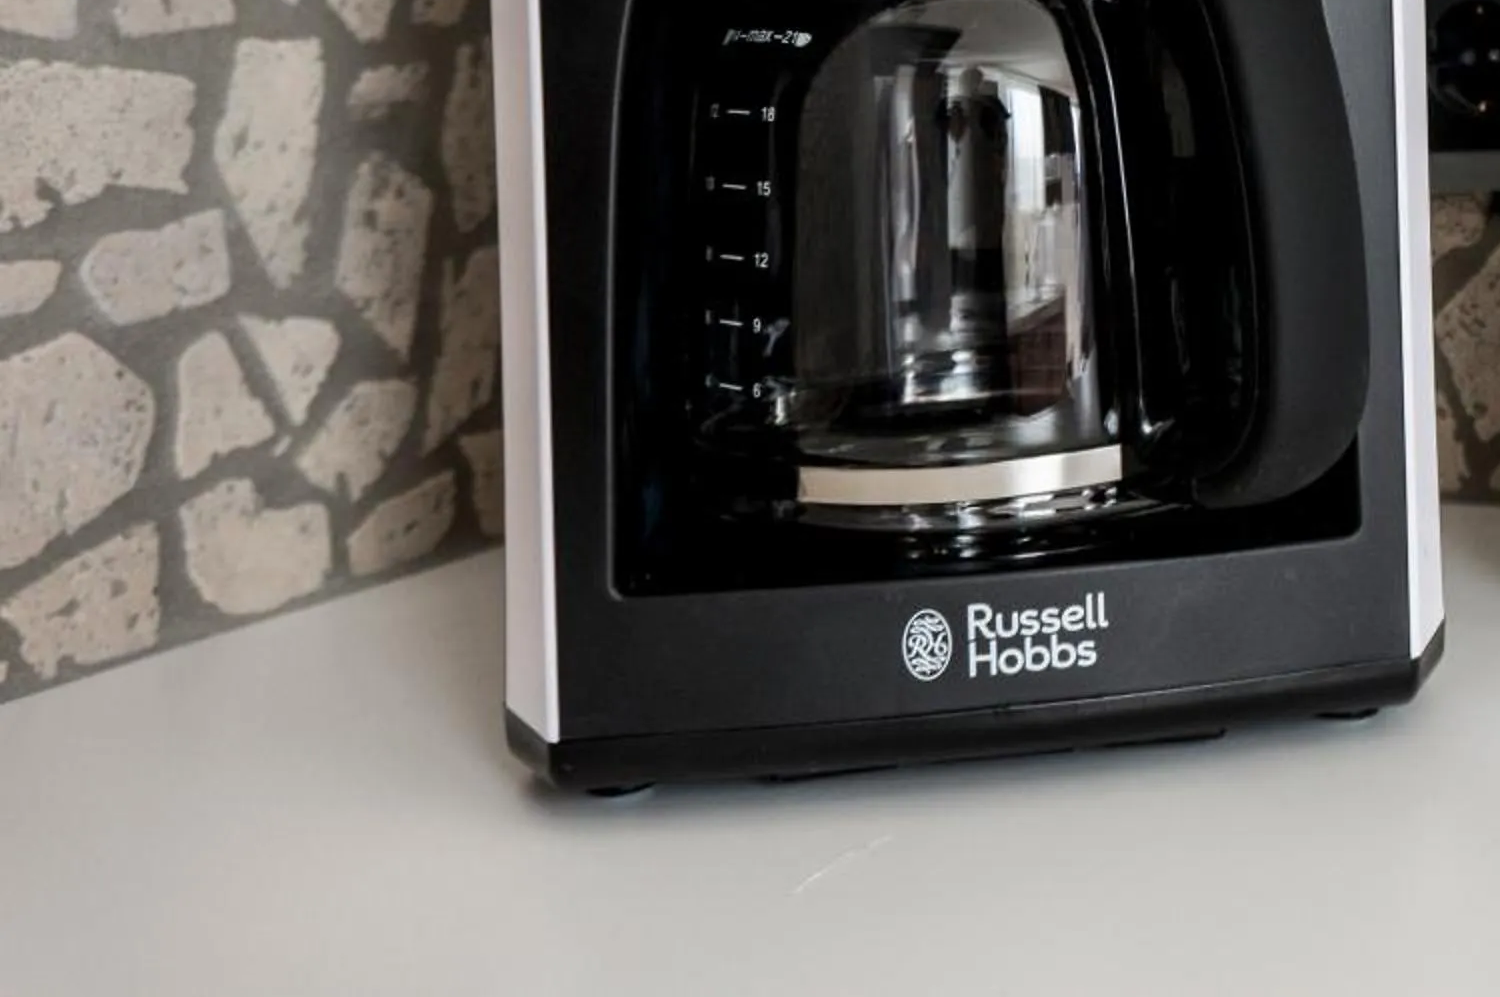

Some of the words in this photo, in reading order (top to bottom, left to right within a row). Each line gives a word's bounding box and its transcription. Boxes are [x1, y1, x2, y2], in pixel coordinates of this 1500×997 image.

[761, 106, 776, 122] 18
[757, 180, 772, 197] 15
[753, 253, 769, 269] 12
[753, 317, 762, 333] 9
[753, 382, 761, 398] 6
[966, 591, 1109, 640] Russell
[967, 634, 1097, 678] Hobbs
